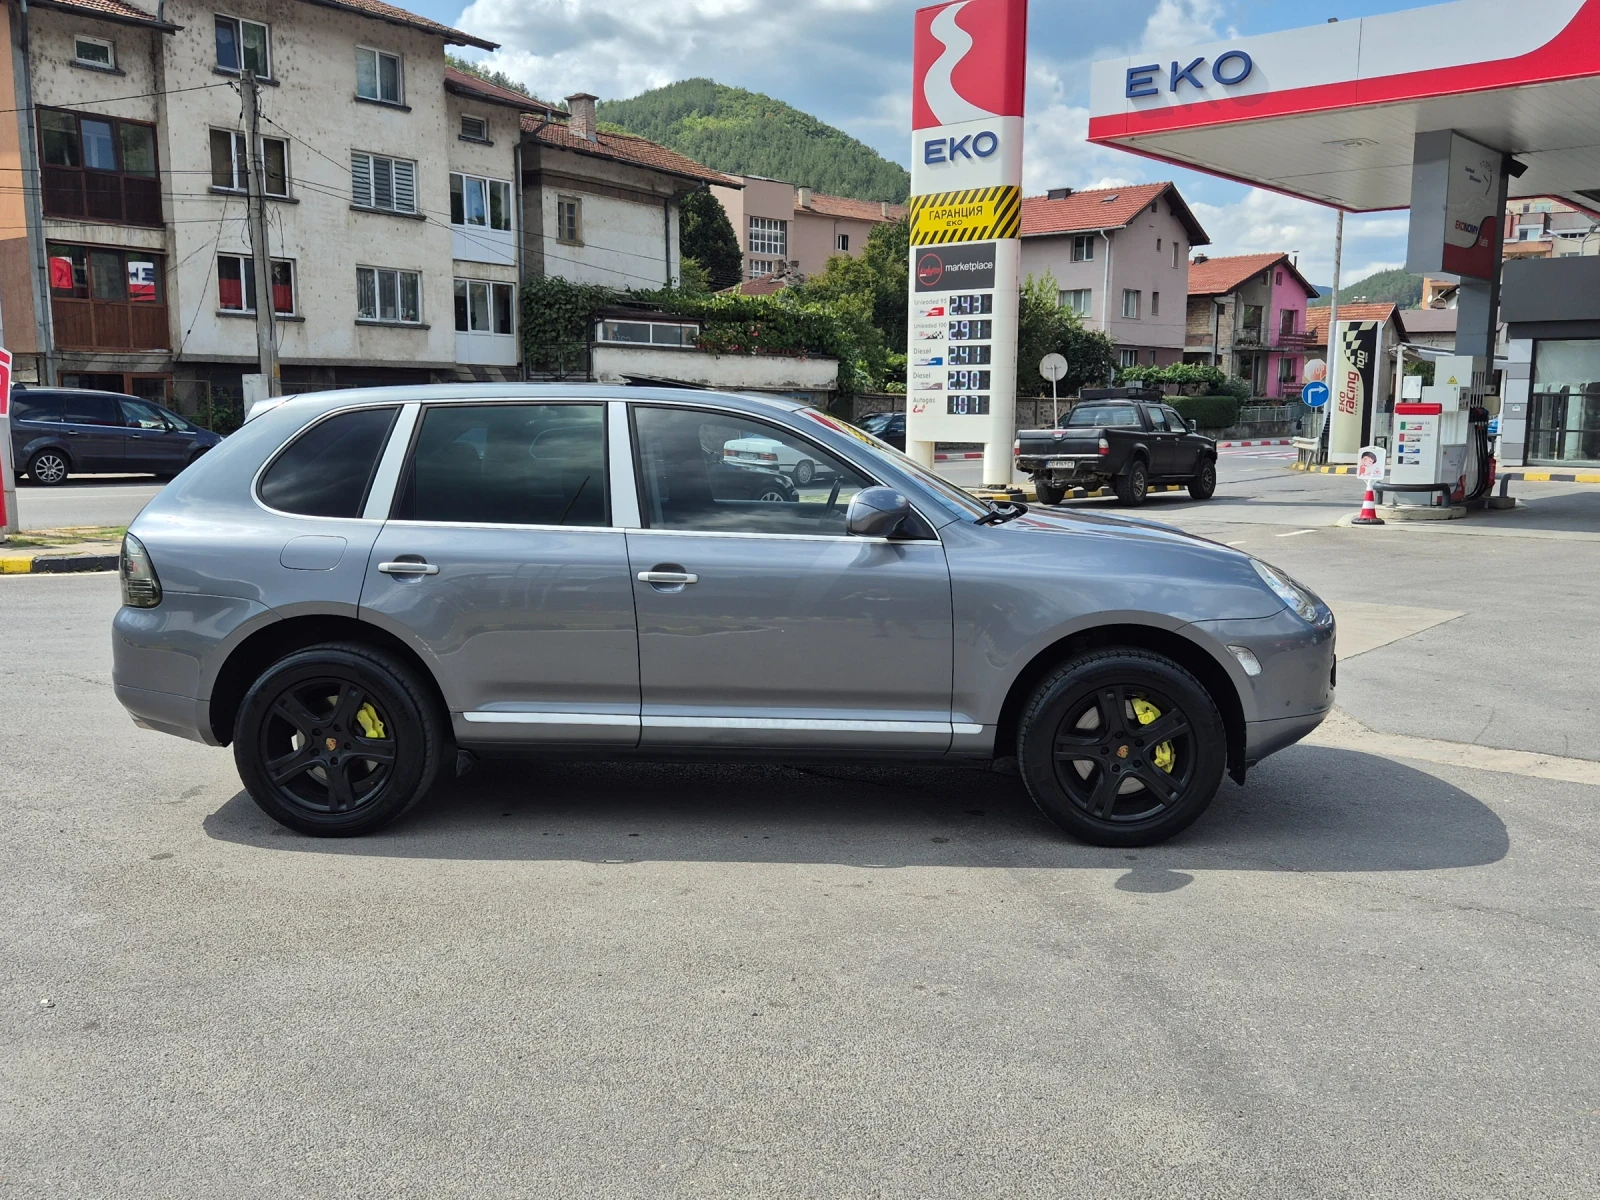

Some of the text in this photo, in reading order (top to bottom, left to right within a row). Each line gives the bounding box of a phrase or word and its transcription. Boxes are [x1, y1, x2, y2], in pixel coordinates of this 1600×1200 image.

[1126, 50, 1253, 98] EKO
[925, 131, 998, 165] EKO
[929, 205, 983, 221] ГАРАНЦИЯ
[945, 261, 993, 272] marketplace
[949, 295, 981, 315] 2.43
[949, 320, 980, 340] 2.91
[948, 346, 980, 365] 2.41
[1357, 350, 1366, 369] 100
[948, 370, 980, 390] 2.90
[1346, 371, 1359, 415] racing
